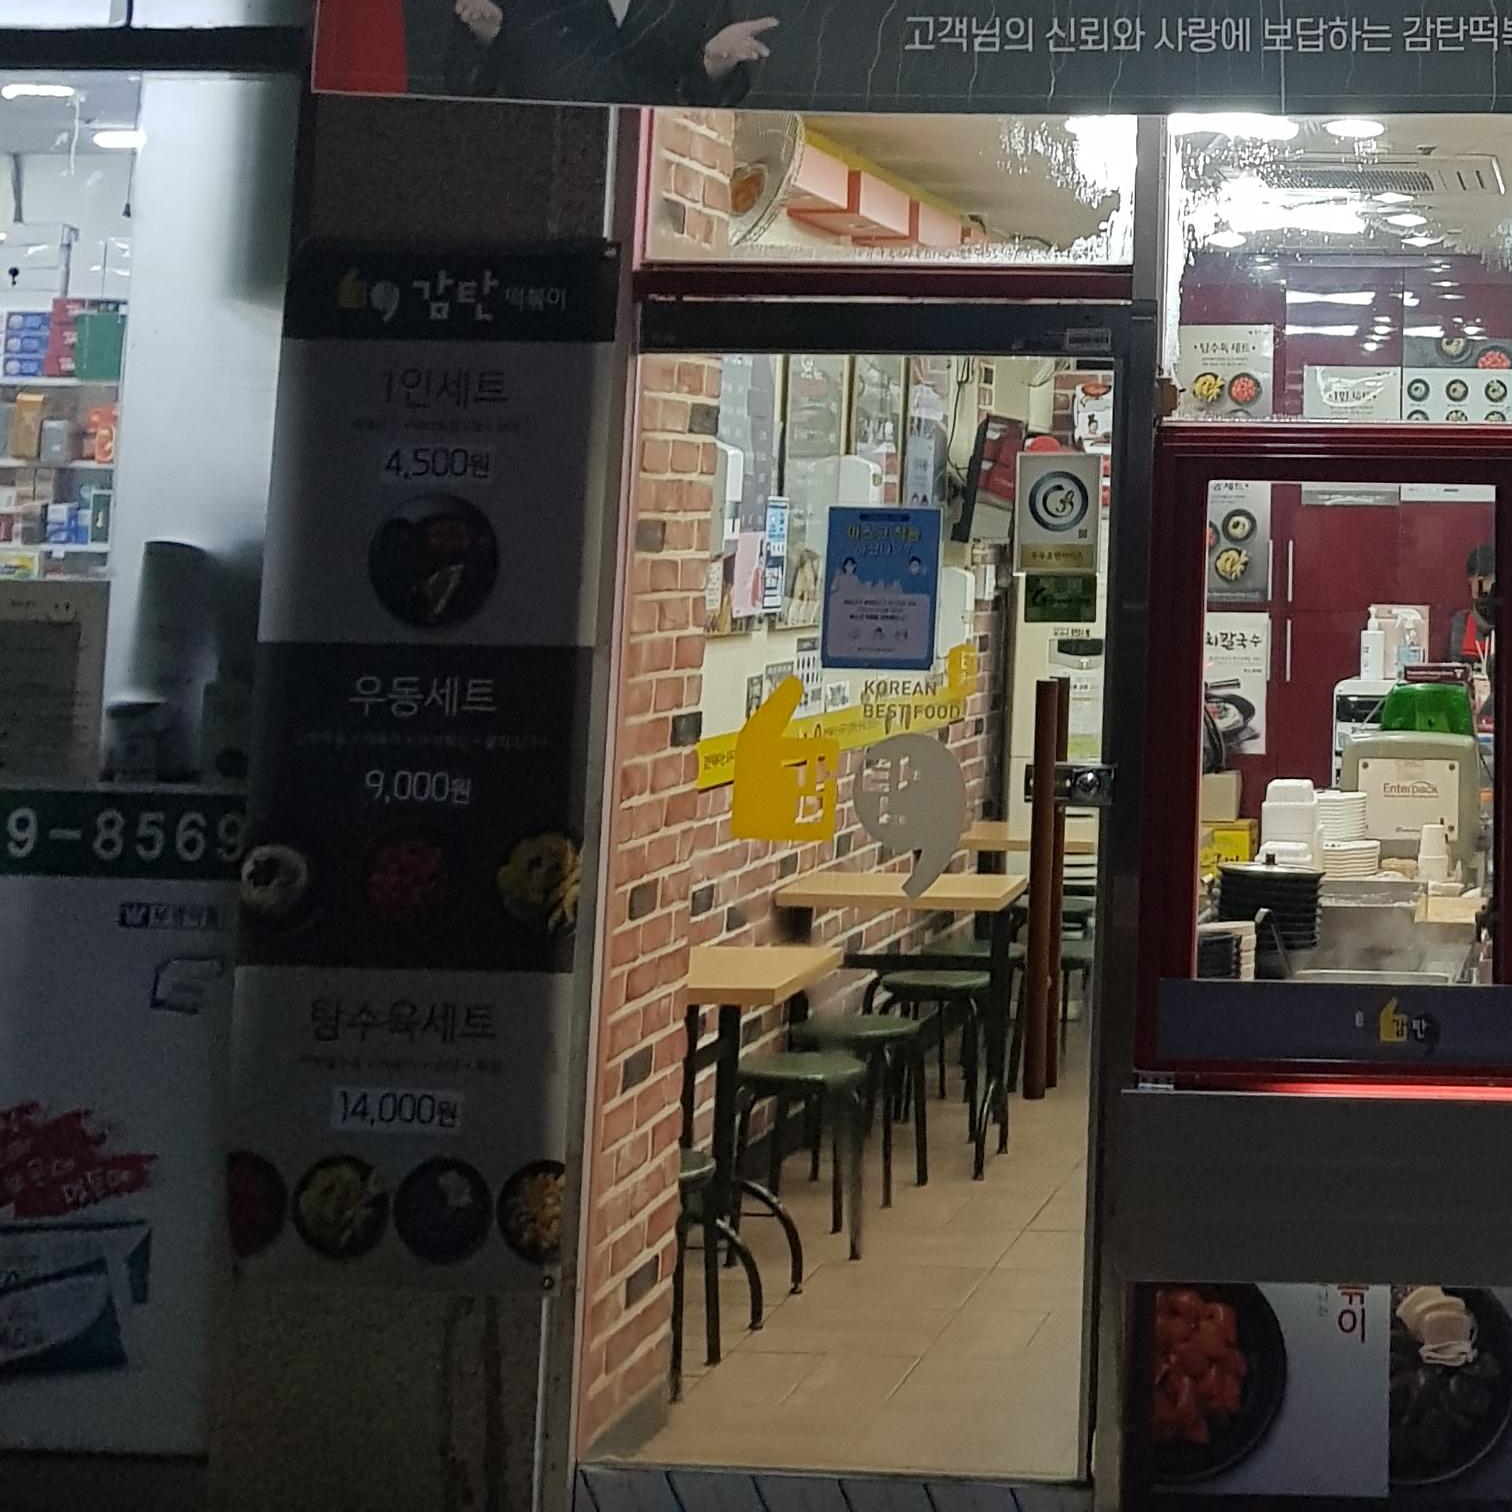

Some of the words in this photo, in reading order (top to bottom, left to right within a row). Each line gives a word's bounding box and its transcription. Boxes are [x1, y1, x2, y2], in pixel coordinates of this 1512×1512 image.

[903, 15, 1035, 55] 고객님의
[1044, 15, 1147, 55] 신뢰와
[1153, 15, 1261, 55] 사랑에
[1261, 15, 1394, 55] 보답하는
[411, 269, 500, 322] 감탄
[381, 366, 510, 410] 1인세트
[348, 672, 499, 719] 우동세트
[863, 679, 938, 698] KOREAN
[862, 702, 912, 720] BEST
[913, 703, 962, 721] FOOD
[1382, 781, 1440, 796] Enterpack
